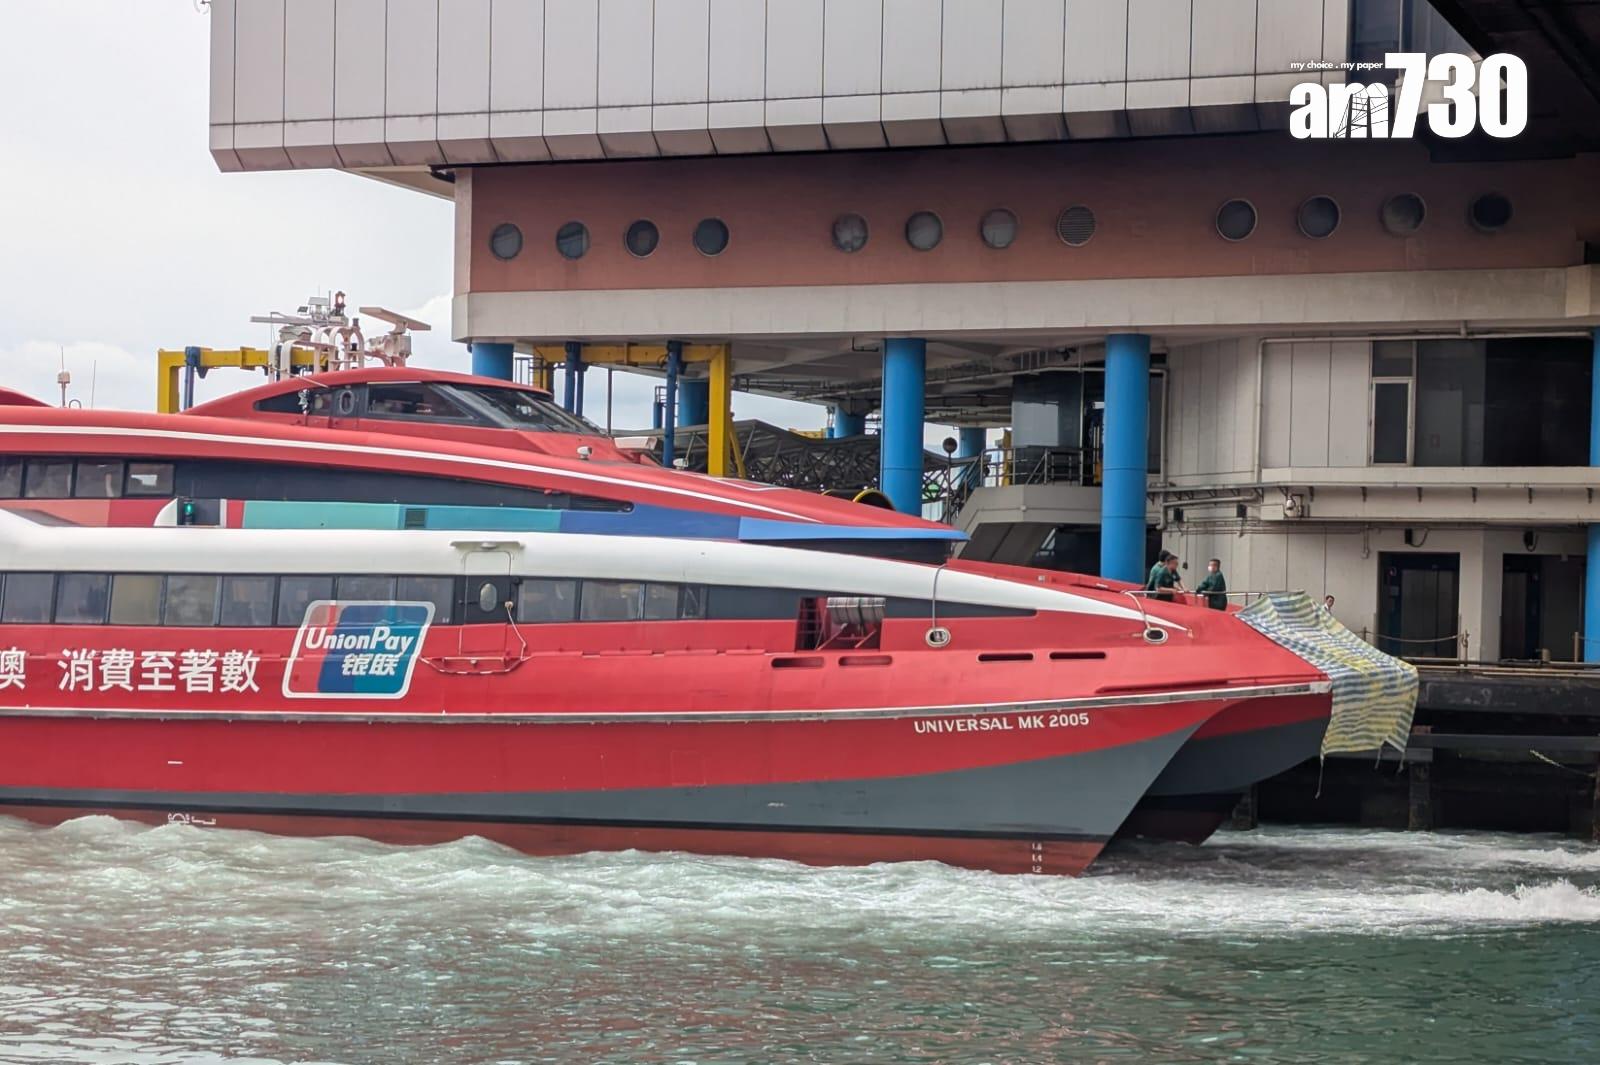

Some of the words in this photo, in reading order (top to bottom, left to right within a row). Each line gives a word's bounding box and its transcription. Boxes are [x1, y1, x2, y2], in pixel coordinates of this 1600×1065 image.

[305, 626, 414, 657] UnionPay
[57, 648, 261, 693] 消費至著數
[341, 653, 399, 676] 银联
[914, 716, 1013, 734] UNIVERSAL
[1018, 715, 1045, 730] MK
[1049, 712, 1090, 728] 2005
